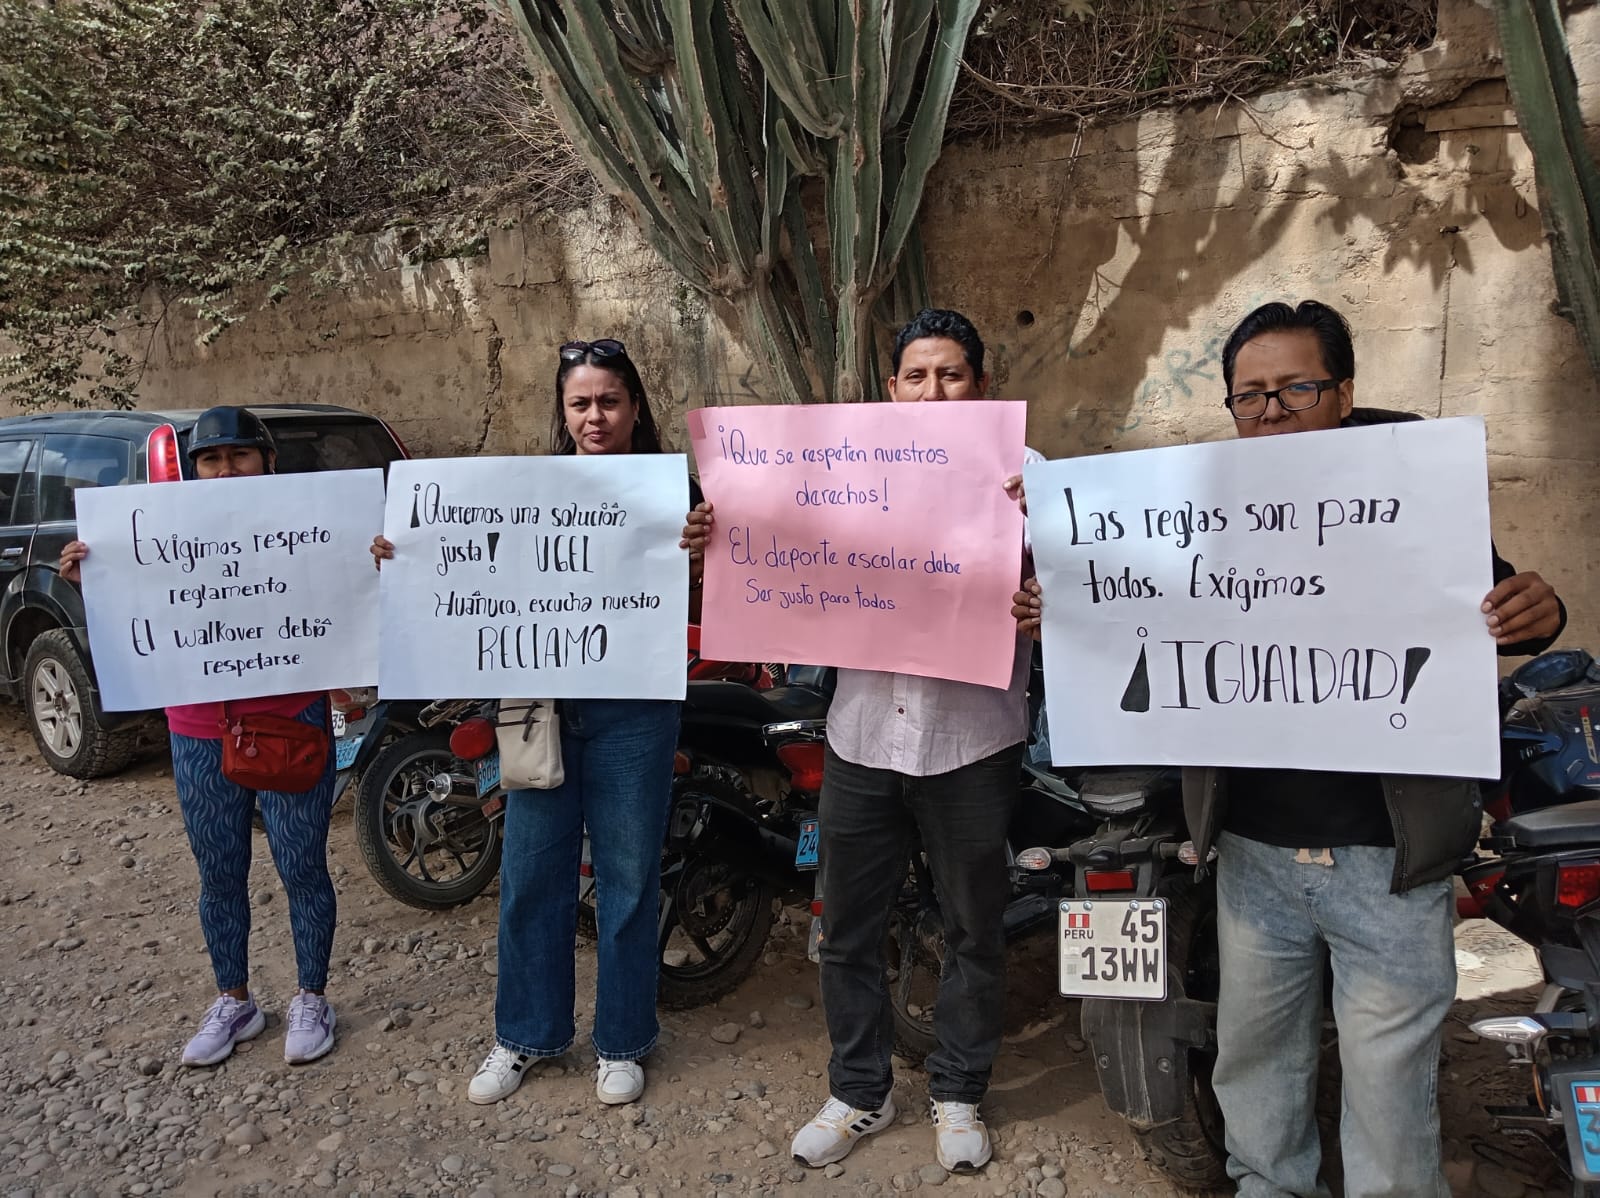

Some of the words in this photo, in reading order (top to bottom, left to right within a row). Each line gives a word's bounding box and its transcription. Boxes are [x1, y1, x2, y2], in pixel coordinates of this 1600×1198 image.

[718, 424, 769, 466] ¡Que
[774, 448, 795, 466] se
[802, 436, 868, 471] respeten
[873, 439, 949, 465] nuestros
[409, 481, 505, 529] ¡Queremos
[510, 506, 541, 526] una
[550, 501, 628, 528] solución
[795, 477, 889, 512] derechos!
[1063, 486, 1125, 546] Las
[1143, 500, 1228, 549] reglas
[1244, 502, 1300, 533] son
[1317, 497, 1401, 548] para
[131, 508, 243, 574] Exigimos
[252, 525, 331, 556] respeto
[436, 531, 501, 577] justa!
[535, 534, 595, 574] UGEL
[728, 525, 758, 566] El
[764, 534, 839, 573] deporte
[847, 546, 918, 571] escolar
[923, 550, 961, 575] debe
[221, 560, 241, 578] al
[1081, 559, 1164, 604] todos.
[1189, 553, 1326, 613] Exigimos
[528, 591, 593, 613] escucha
[601, 591, 661, 611] nuestro
[745, 578, 774, 604] Ser
[778, 583, 814, 610] justo
[819, 590, 851, 613] para
[131, 617, 156, 657] El
[477, 622, 608, 672] RECLAMO
[1119, 626, 1432, 730] ¡IGUALDAD!
[799, 833, 817, 856] 24
[1064, 929, 1094, 940] PERU
[1121, 909, 1159, 943] 45
[1081, 946, 1159, 983] 13WW
